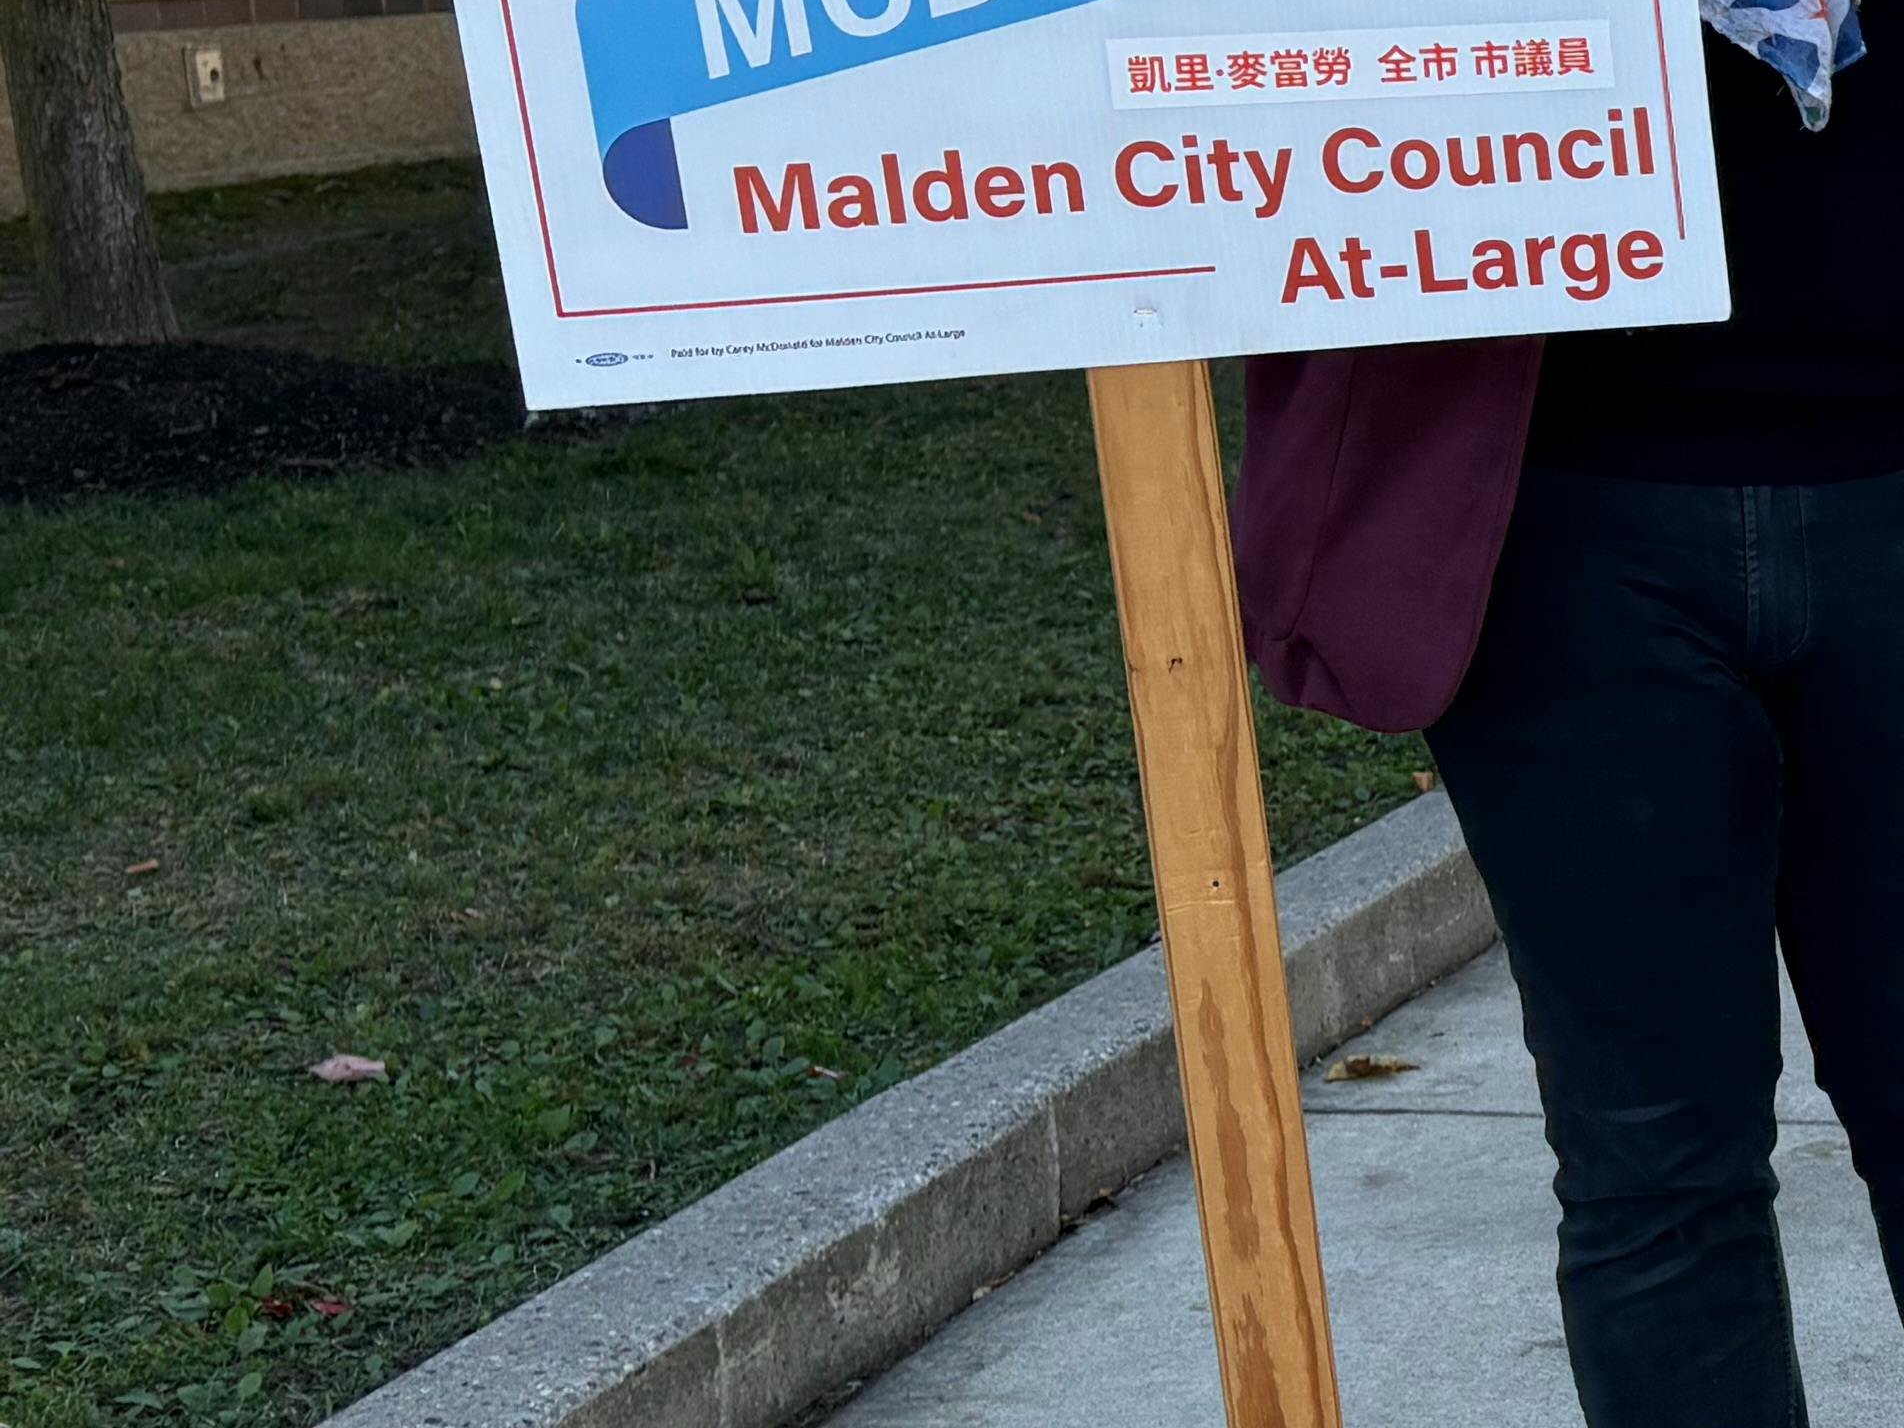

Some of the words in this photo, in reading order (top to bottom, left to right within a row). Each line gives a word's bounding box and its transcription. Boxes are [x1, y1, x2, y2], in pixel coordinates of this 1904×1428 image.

[1378, 43, 1458, 85] 全市
[1472, 37, 1595, 79] 市議員
[735, 150, 1085, 234] Malden
[1115, 136, 1293, 220] City
[1323, 108, 1654, 194] Council
[1282, 230, 1664, 306] At-Large
